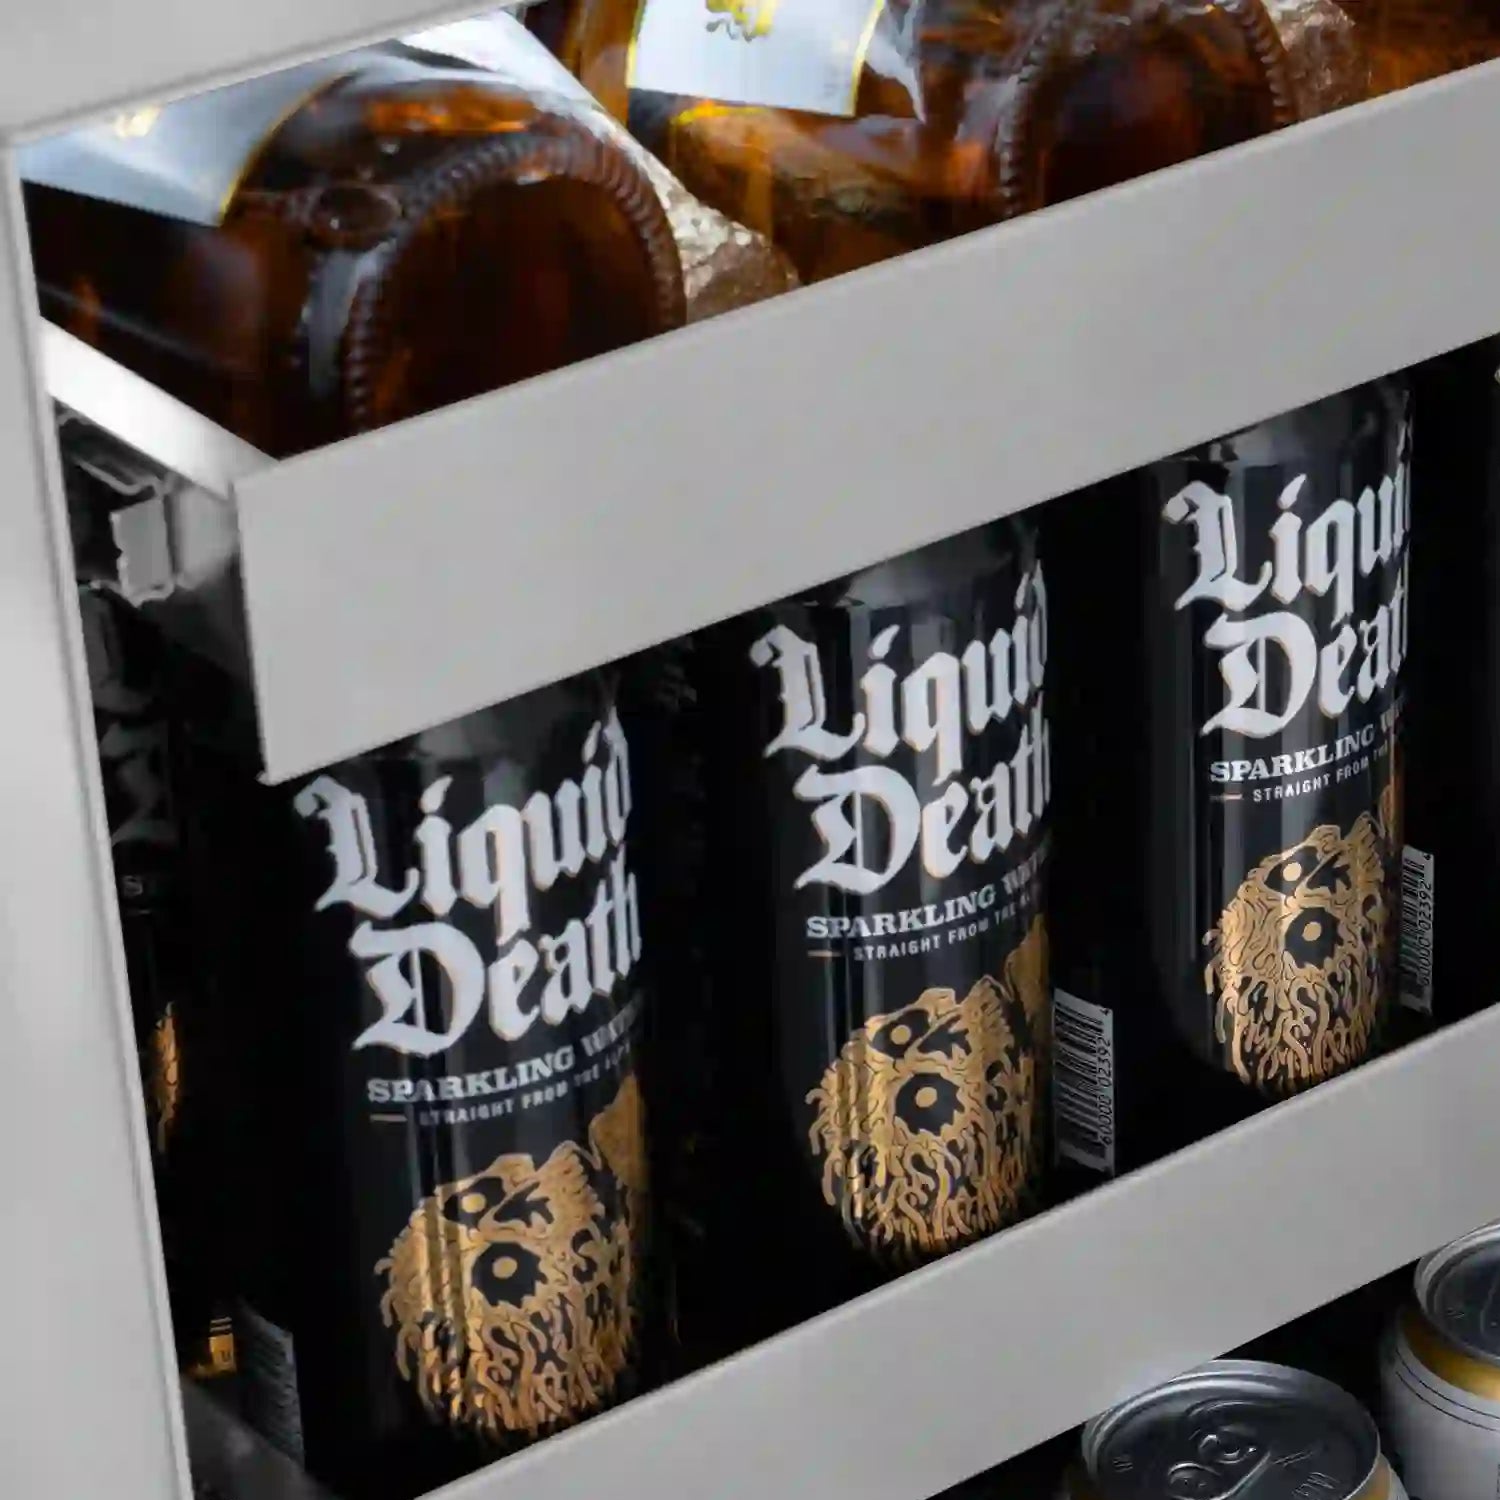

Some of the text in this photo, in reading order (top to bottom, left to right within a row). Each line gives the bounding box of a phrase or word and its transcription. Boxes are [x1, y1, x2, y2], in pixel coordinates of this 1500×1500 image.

[1210, 723, 1374, 783] SPARKLING
[1253, 761, 1369, 802] STRAIGHT FROM
[294, 704, 632, 945] Liquid
[806, 884, 996, 938] SPARKLING
[347, 842, 642, 1058] Death
[854, 936, 940, 961] STRAIGHT
[947, 920, 988, 944] FROM
[367, 1046, 575, 1104] SPARKLING
[418, 1094, 514, 1126] STRAIGHT
[521, 1079, 568, 1108] FROM
